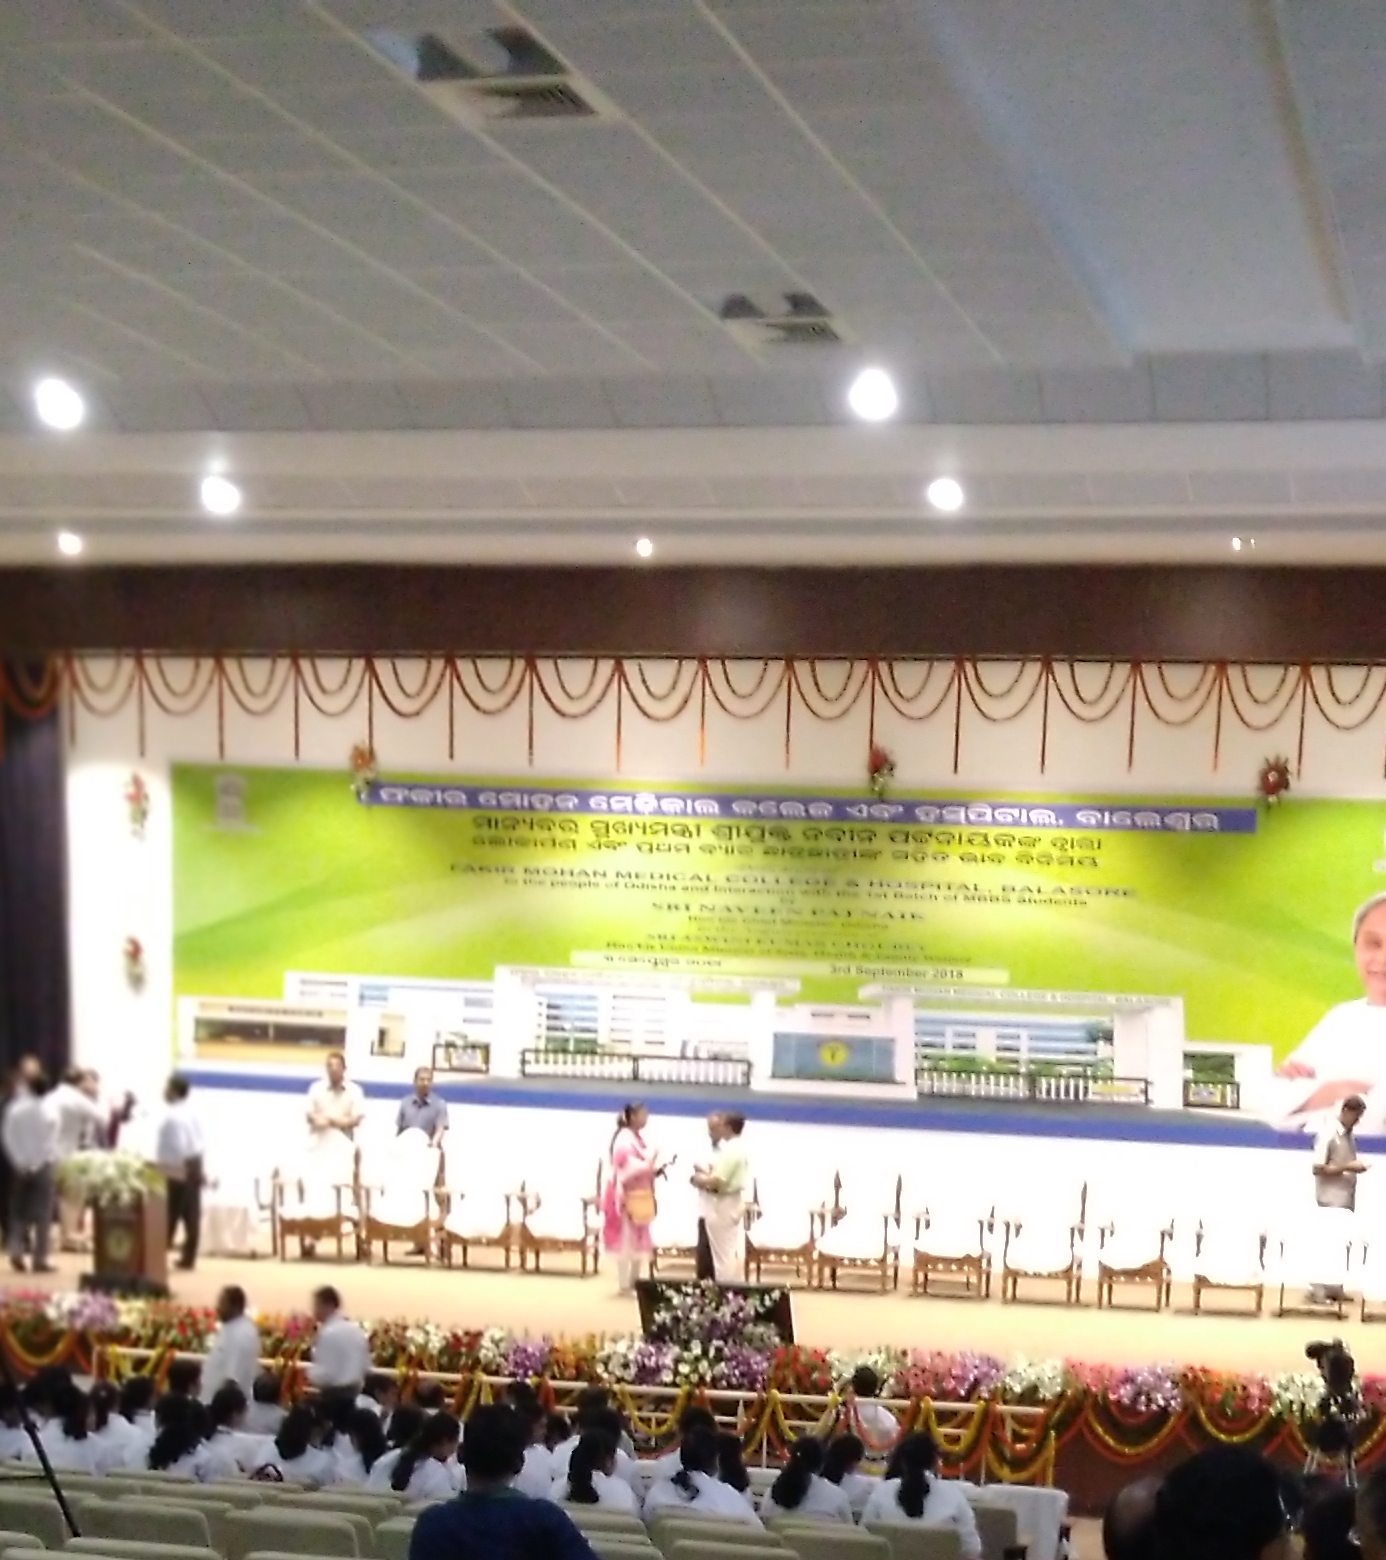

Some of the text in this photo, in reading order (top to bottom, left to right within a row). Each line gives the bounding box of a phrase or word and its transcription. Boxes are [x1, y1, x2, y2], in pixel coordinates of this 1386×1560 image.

[379, 787, 467, 806] ଫକୀର
[478, 791, 579, 811] ମୋହନ
[731, 799, 833, 818] କଲେଜ
[846, 802, 904, 820] ଏବଂ
[523, 866, 608, 879] MOHAN
[615, 870, 717, 884] MEDICAL
[725, 873, 835, 888] COLLEGE
[1000, 883, 1136, 898] BALASORE
[550, 880, 601, 890] people
[624, 881, 677, 892] Odisha
[681, 883, 710, 893] and
[830, 964, 964, 982] 3rd September 2018
